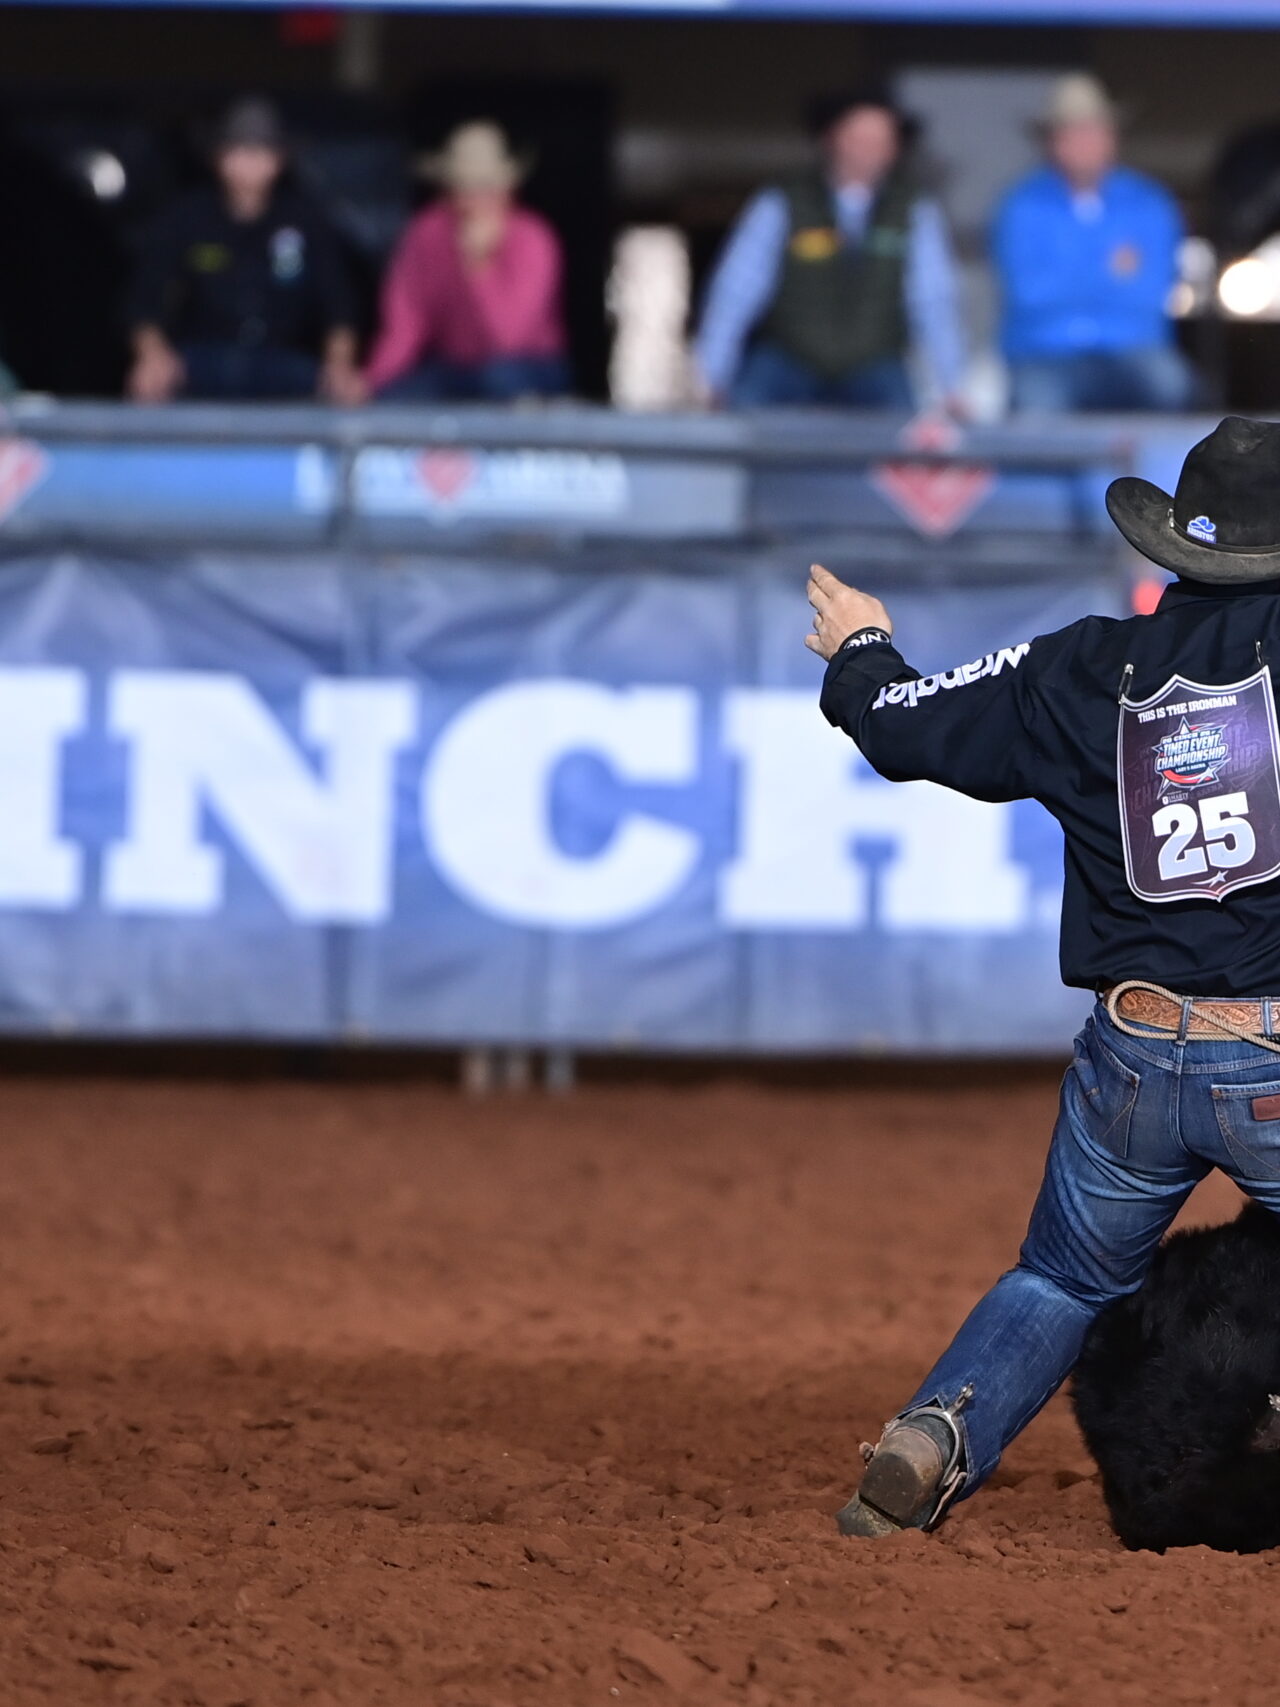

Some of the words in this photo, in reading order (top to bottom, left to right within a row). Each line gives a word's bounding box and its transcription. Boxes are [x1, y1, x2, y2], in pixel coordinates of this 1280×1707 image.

[872, 642, 1031, 710] Wrangler
[1137, 709, 1156, 723] THIS
[1156, 706, 1166, 719] IS
[1166, 702, 1188, 716] THE
[1188, 695, 1237, 713] IRONMAN
[1157, 745, 1226, 771] CHAMPIONSHIP
[1163, 739, 1190, 756] TIMED
[1189, 734, 1220, 752] EVENT
[1151, 791, 1256, 881] 25
